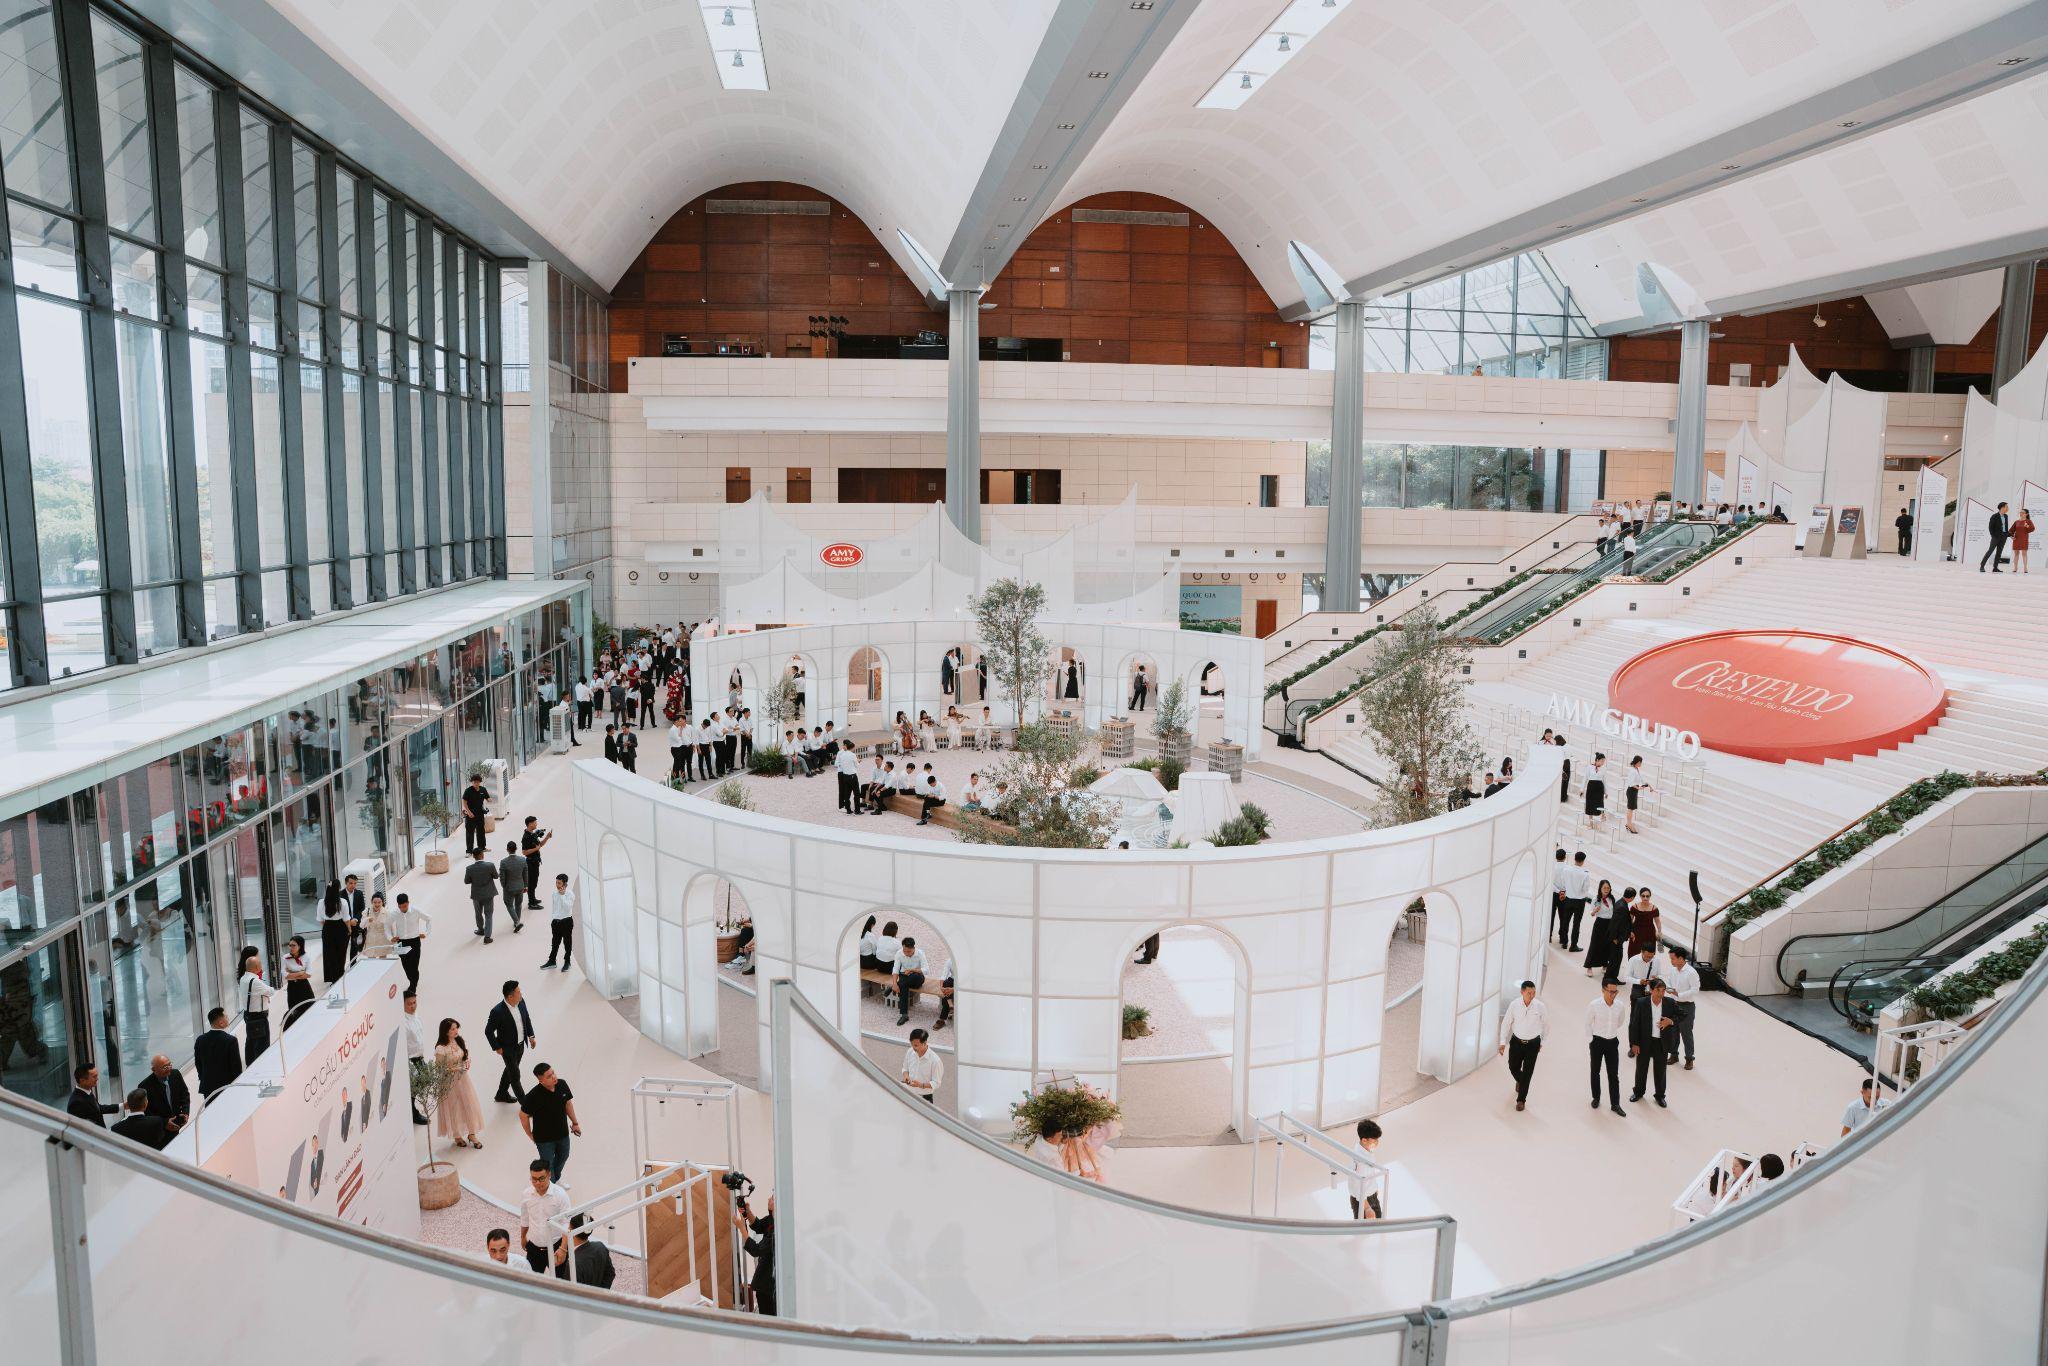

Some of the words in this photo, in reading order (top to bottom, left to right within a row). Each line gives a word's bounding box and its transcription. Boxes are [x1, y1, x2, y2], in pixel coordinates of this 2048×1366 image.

[830, 549, 855, 557] AMY
[1672, 660, 1854, 713] CRESTENDO
[1546, 692, 1597, 729] AMY
[1600, 707, 1702, 761] GRUPO
[319, 1052, 338, 1086] CẤU
[338, 1033, 351, 1063] TỔ
[351, 1012, 375, 1049] CHỨC
